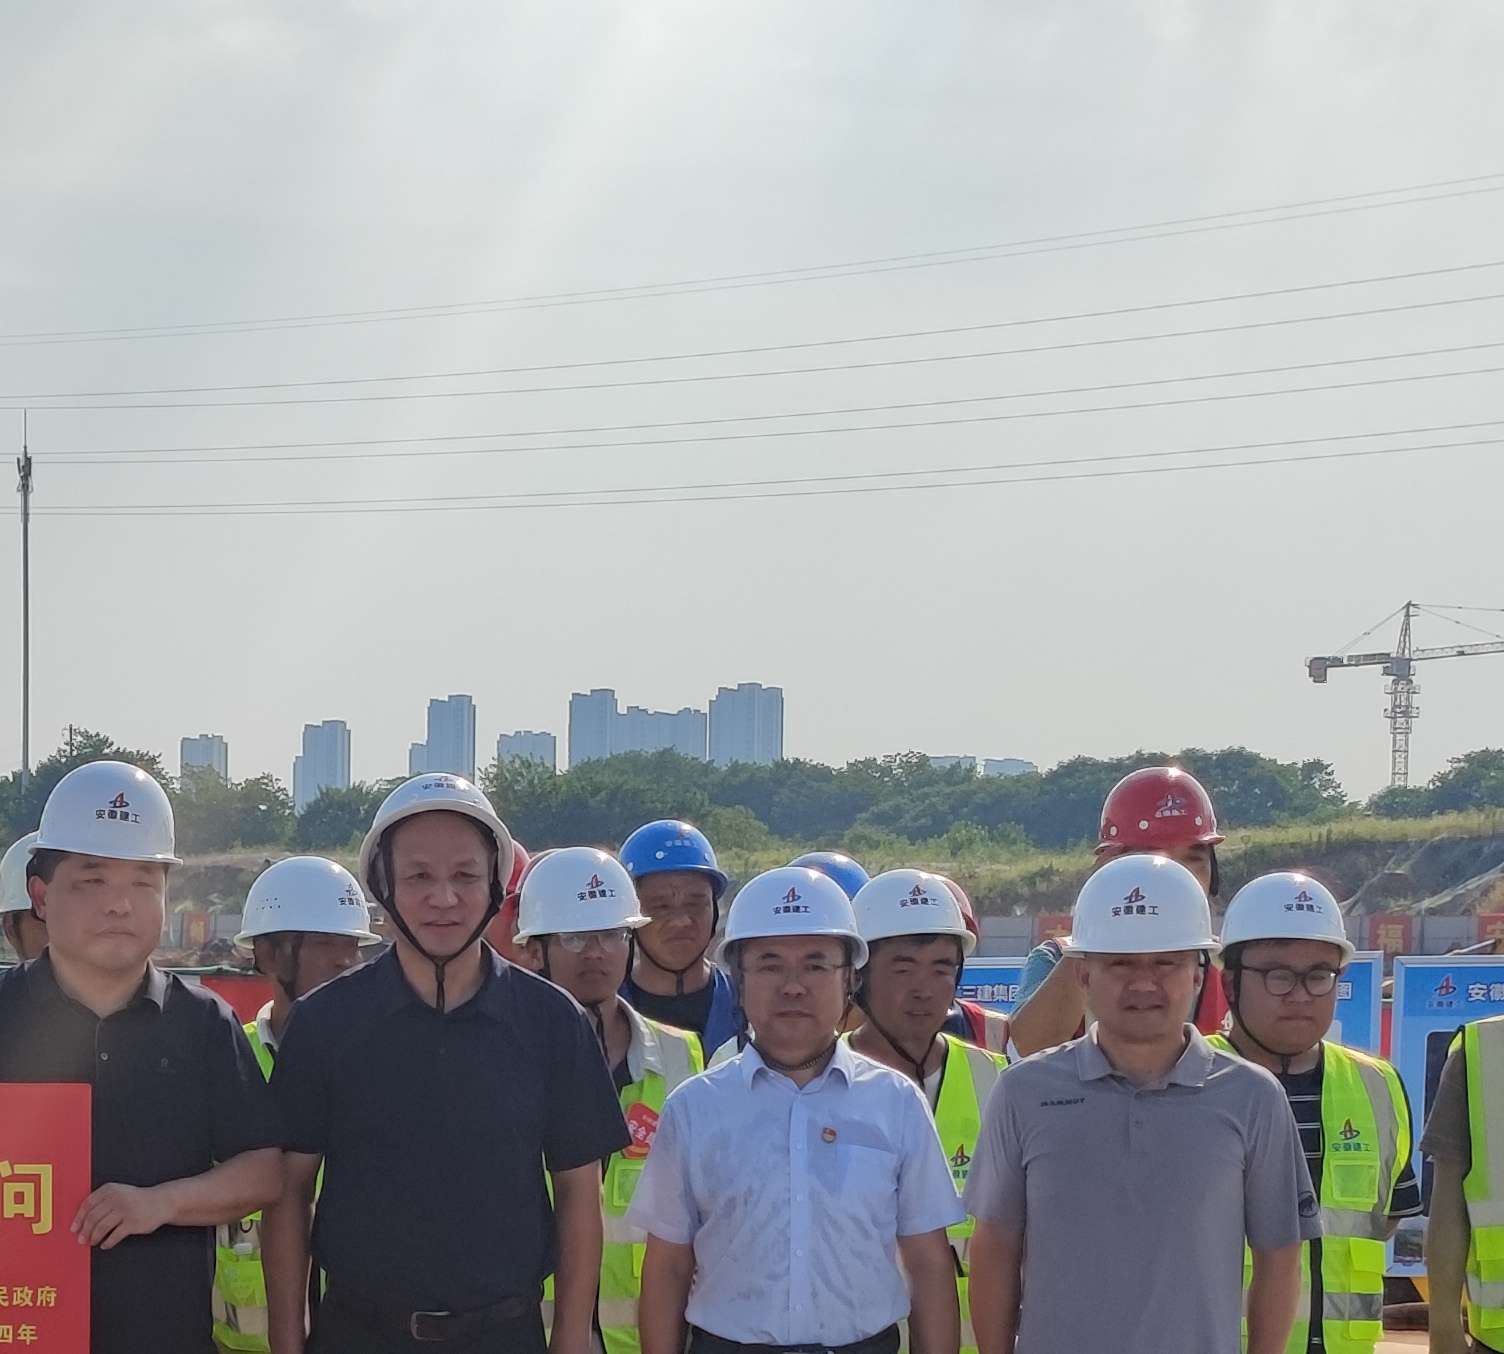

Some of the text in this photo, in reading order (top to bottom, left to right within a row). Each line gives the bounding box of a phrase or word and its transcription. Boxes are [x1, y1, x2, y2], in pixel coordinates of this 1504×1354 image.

[95, 807, 141, 825] 安徽建工
[577, 888, 617, 902] 安徽建工
[772, 904, 811, 916] 安徽建工
[1111, 904, 1159, 916] 安徽建工
